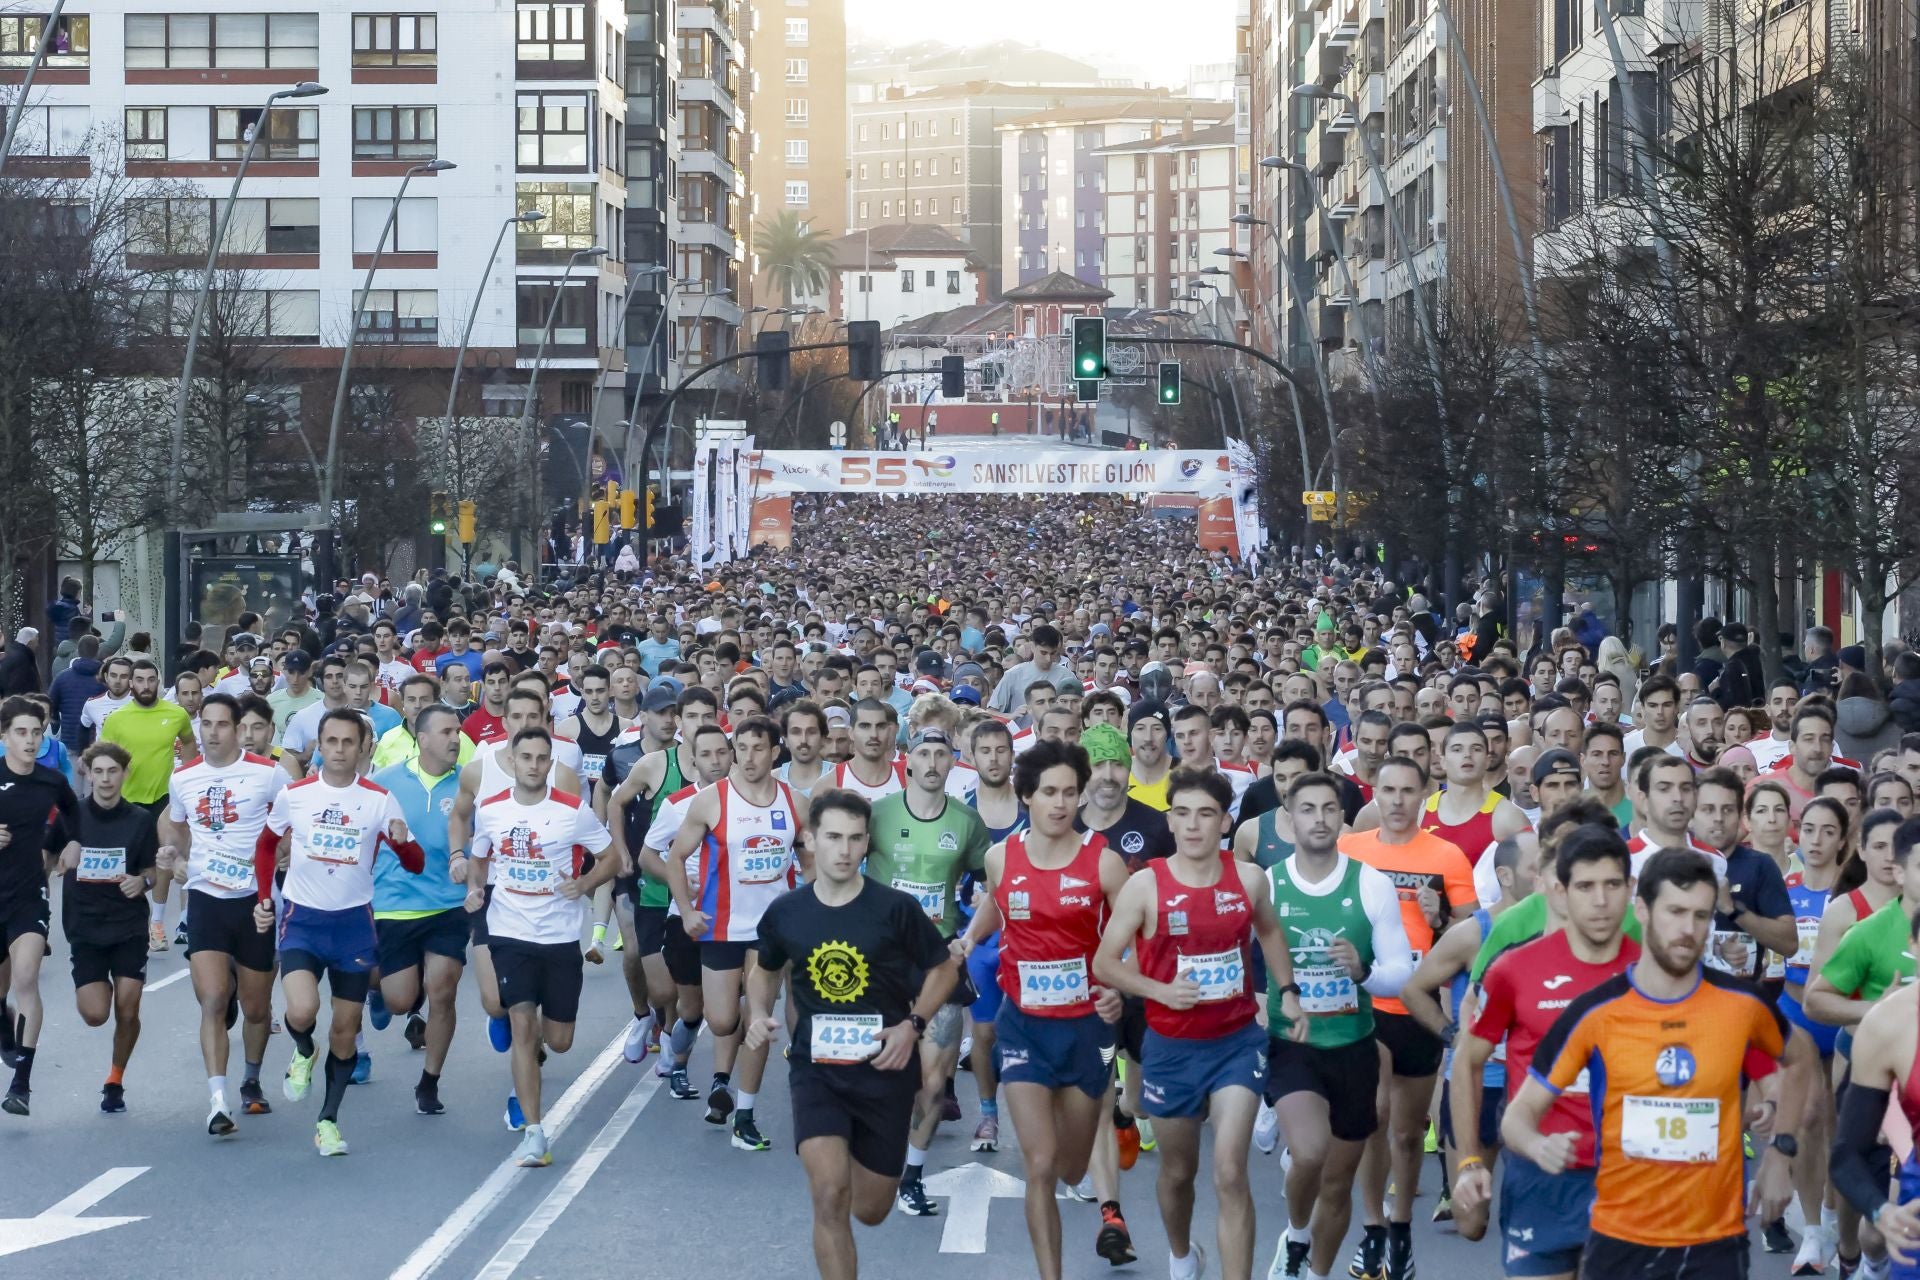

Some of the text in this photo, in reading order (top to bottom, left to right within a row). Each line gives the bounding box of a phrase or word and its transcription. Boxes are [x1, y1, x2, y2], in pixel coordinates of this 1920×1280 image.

[840, 457, 907, 486] 55
[973, 459, 1156, 483] SANSILVESTRE GIJÓN
[312, 832, 356, 850] 5220
[513, 841, 528, 849] SIL
[83, 857, 119, 869] 2767
[207, 858, 248, 880] 2508
[744, 856, 782, 871] 3510
[1027, 972, 1081, 991] 4960
[1299, 979, 1350, 998] 2632
[819, 1026, 873, 1045] 4236
[1655, 1117, 1688, 1140] 18
